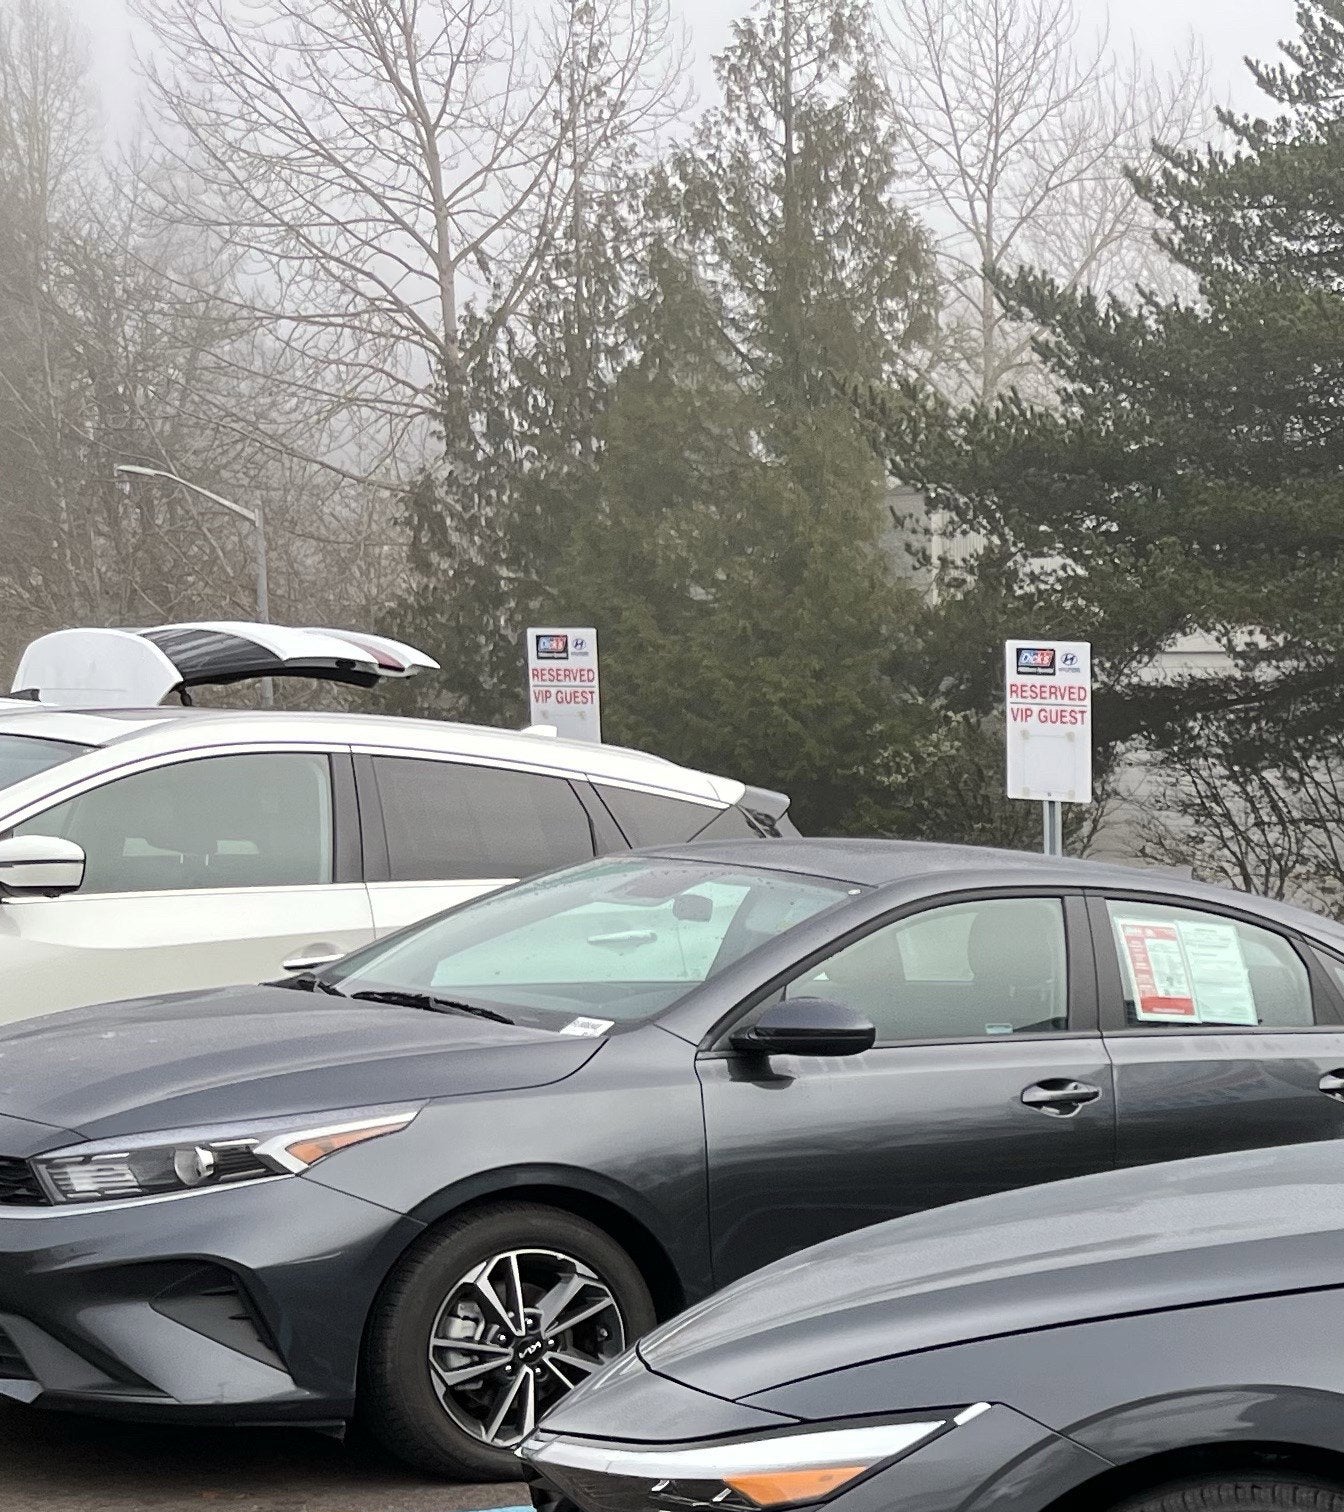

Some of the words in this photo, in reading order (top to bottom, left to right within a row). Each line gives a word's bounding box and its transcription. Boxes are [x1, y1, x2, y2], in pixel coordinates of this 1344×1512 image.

[531, 668, 595, 684] RESERVED
[533, 689, 552, 704] VIP
[555, 689, 595, 705] GUEST
[1009, 683, 1088, 702] RESERVED
[1010, 707, 1033, 723] VIP
[1037, 707, 1088, 726] GUEST
